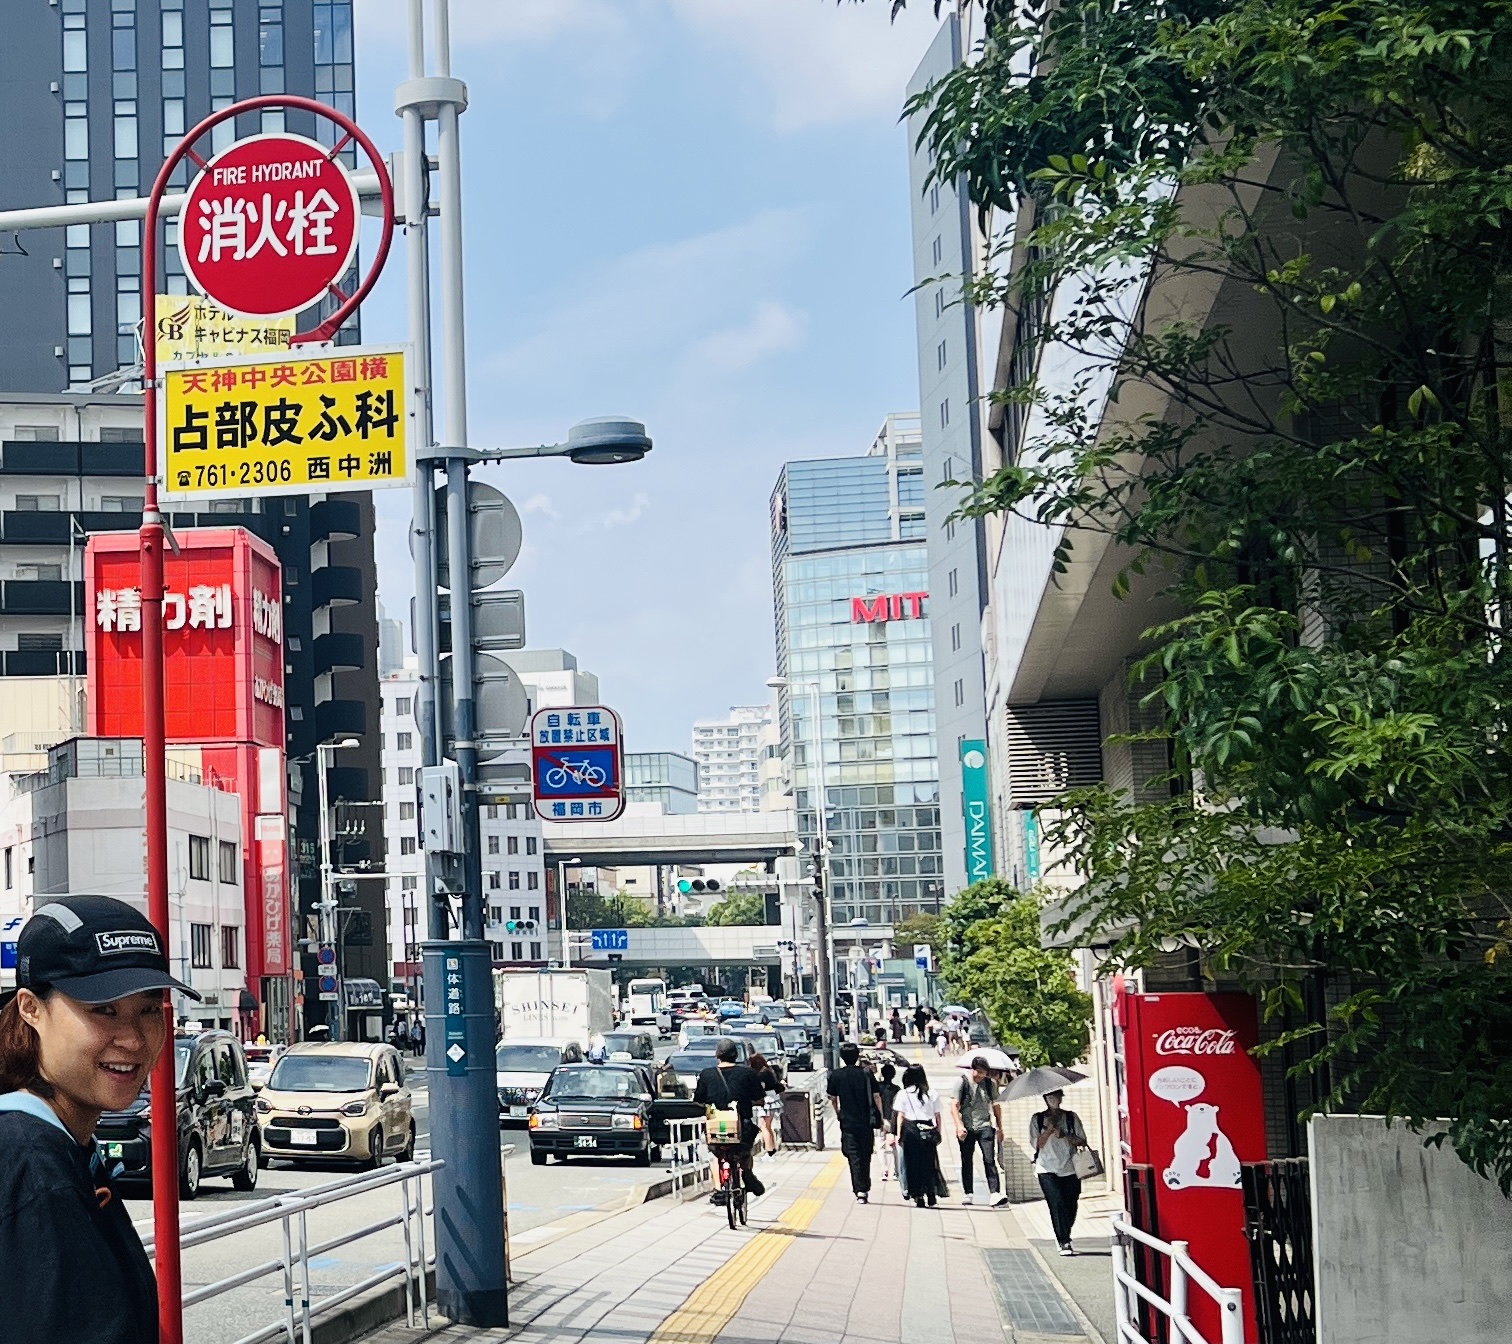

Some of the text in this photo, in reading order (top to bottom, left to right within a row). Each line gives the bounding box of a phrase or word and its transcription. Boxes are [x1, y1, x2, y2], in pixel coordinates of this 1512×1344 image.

[213, 159, 323, 187] FIRE HYDRANT
[197, 189, 339, 263] 消火栓
[194, 327, 291, 346] キャビナス福岡
[182, 359, 389, 395] 天神中央公園横
[173, 389, 399, 453] 占部皮ふ科
[306, 450, 392, 482] 西中洲
[851, 591, 929, 624] MIT
[547, 712, 601, 727] 自転車
[539, 728, 610, 743] 放置禁止区域
[552, 802, 603, 817] 福岡市
[102, 932, 153, 949] Supreme
[512, 1001, 578, 1015] SHINSEI
